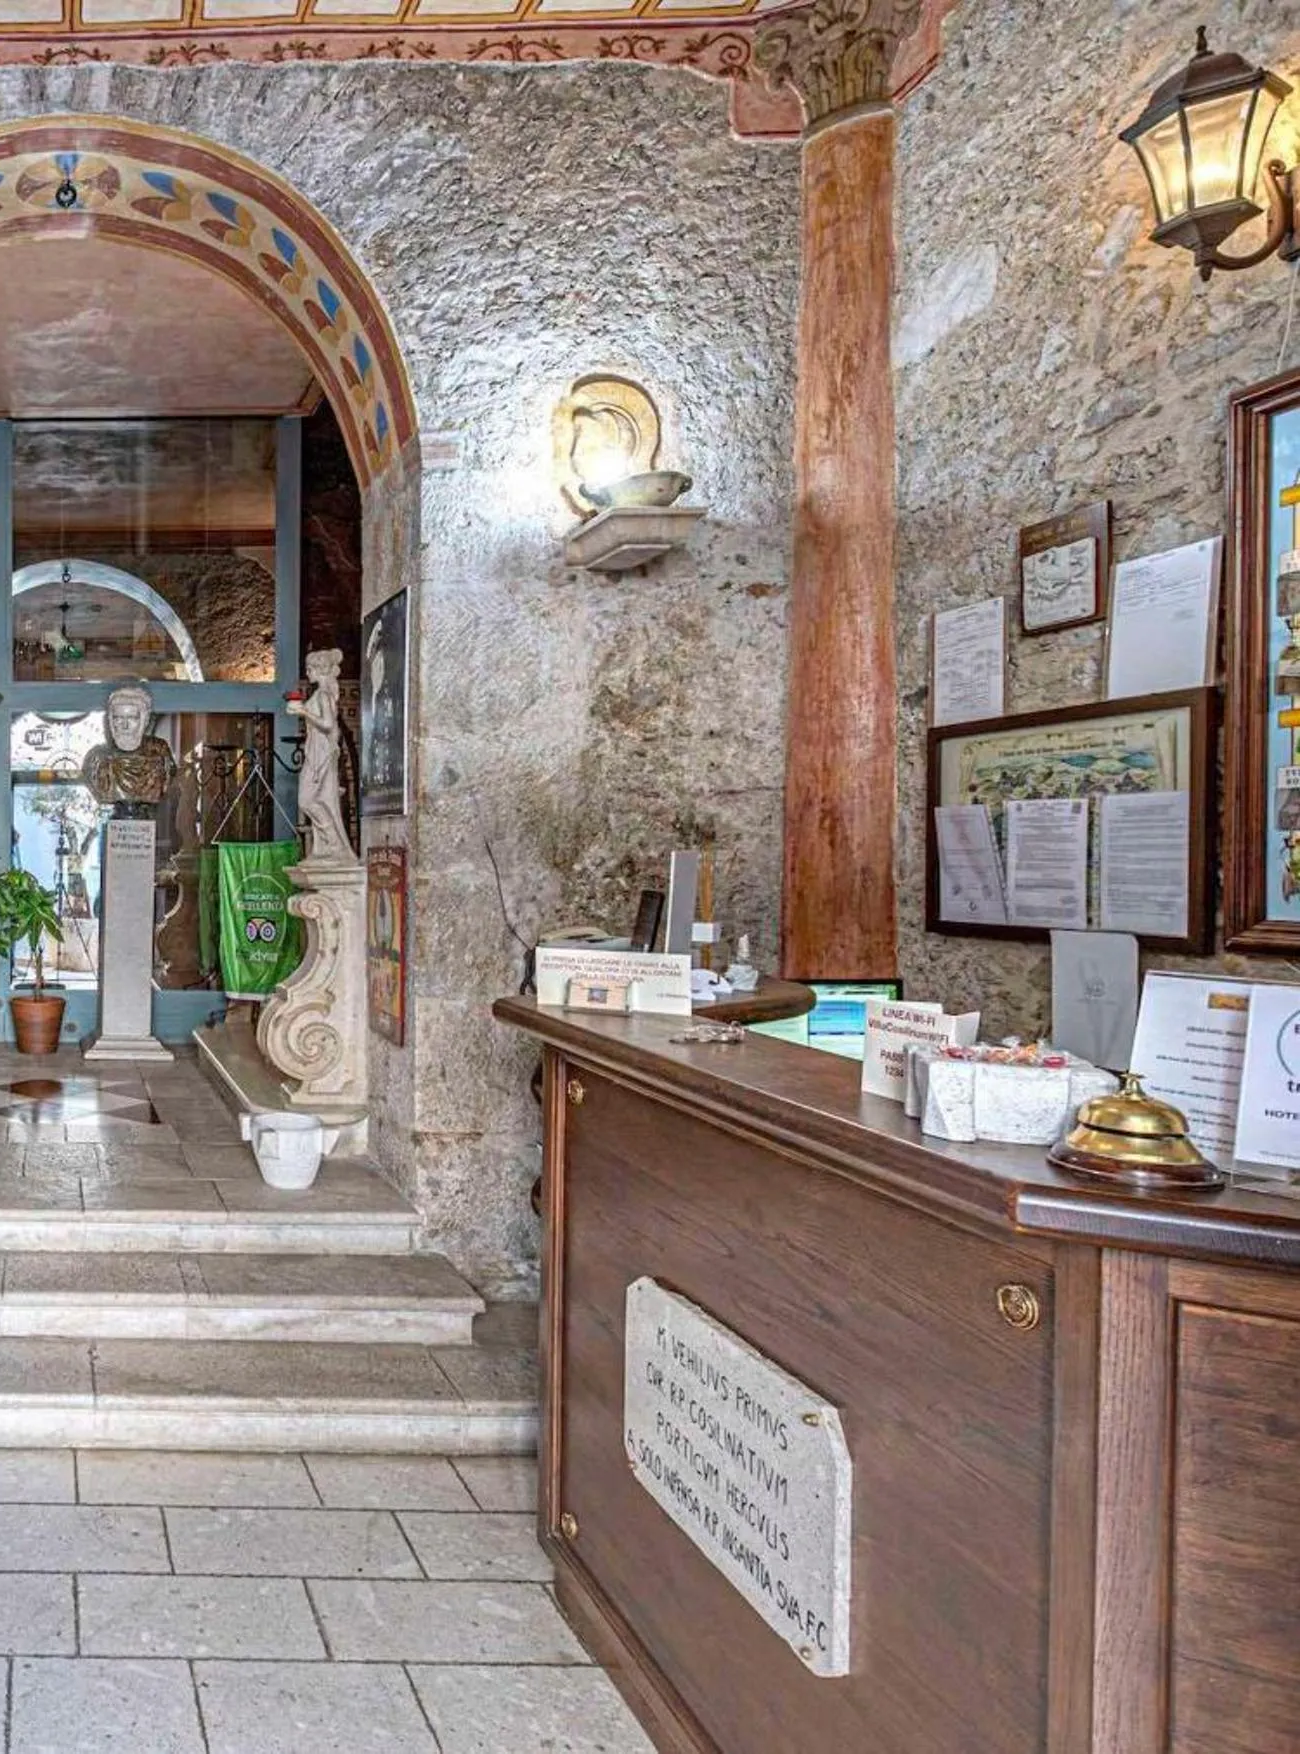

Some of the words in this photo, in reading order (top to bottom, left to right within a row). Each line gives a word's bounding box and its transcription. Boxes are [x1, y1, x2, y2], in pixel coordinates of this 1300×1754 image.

[882, 1007, 912, 1021] LINEA
[736, 1386, 788, 1451] PRIMVS
[638, 1437, 663, 1481] SOLO
[657, 1411, 720, 1493] PORTICVM
